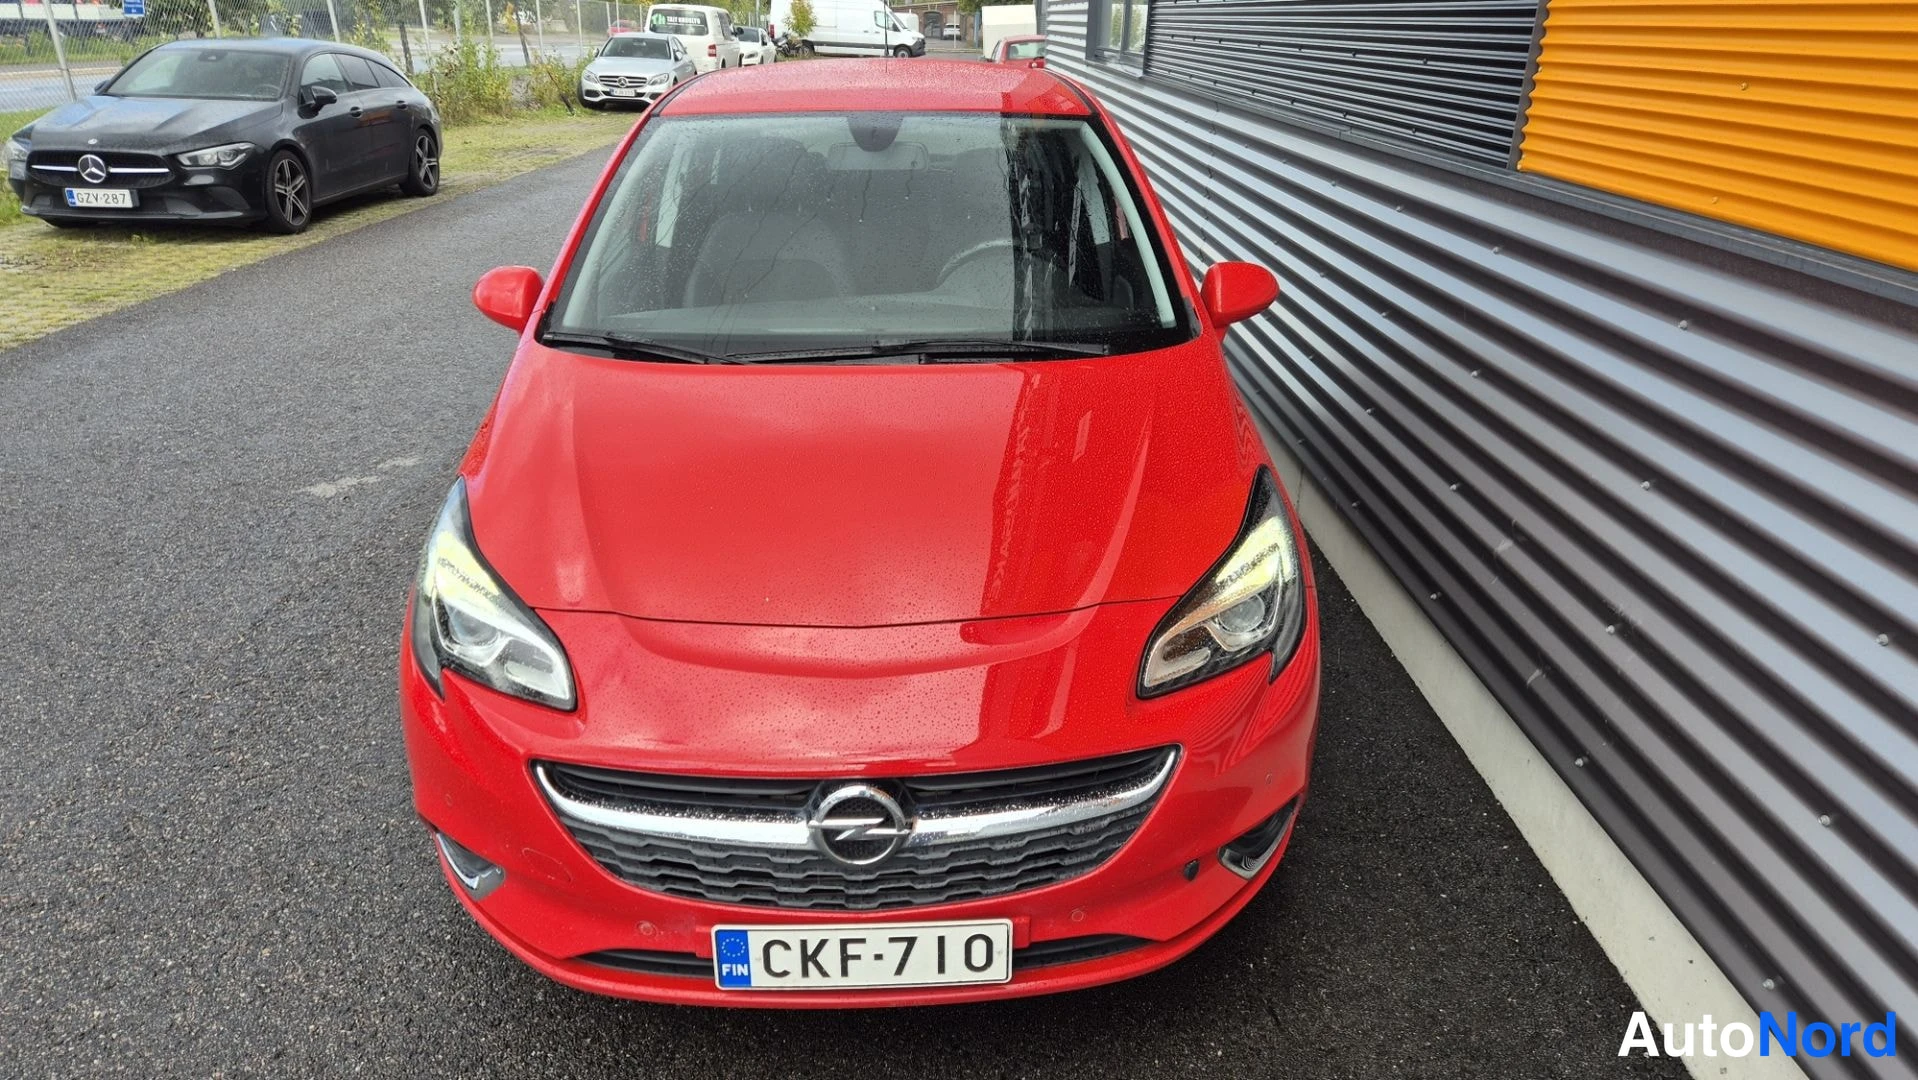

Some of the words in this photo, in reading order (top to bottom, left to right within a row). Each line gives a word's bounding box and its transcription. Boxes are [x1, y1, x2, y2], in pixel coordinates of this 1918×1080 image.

[76, 192, 126, 204] GZV-287
[761, 933, 994, 978] CKF-710
[721, 963, 749, 977] FIN
